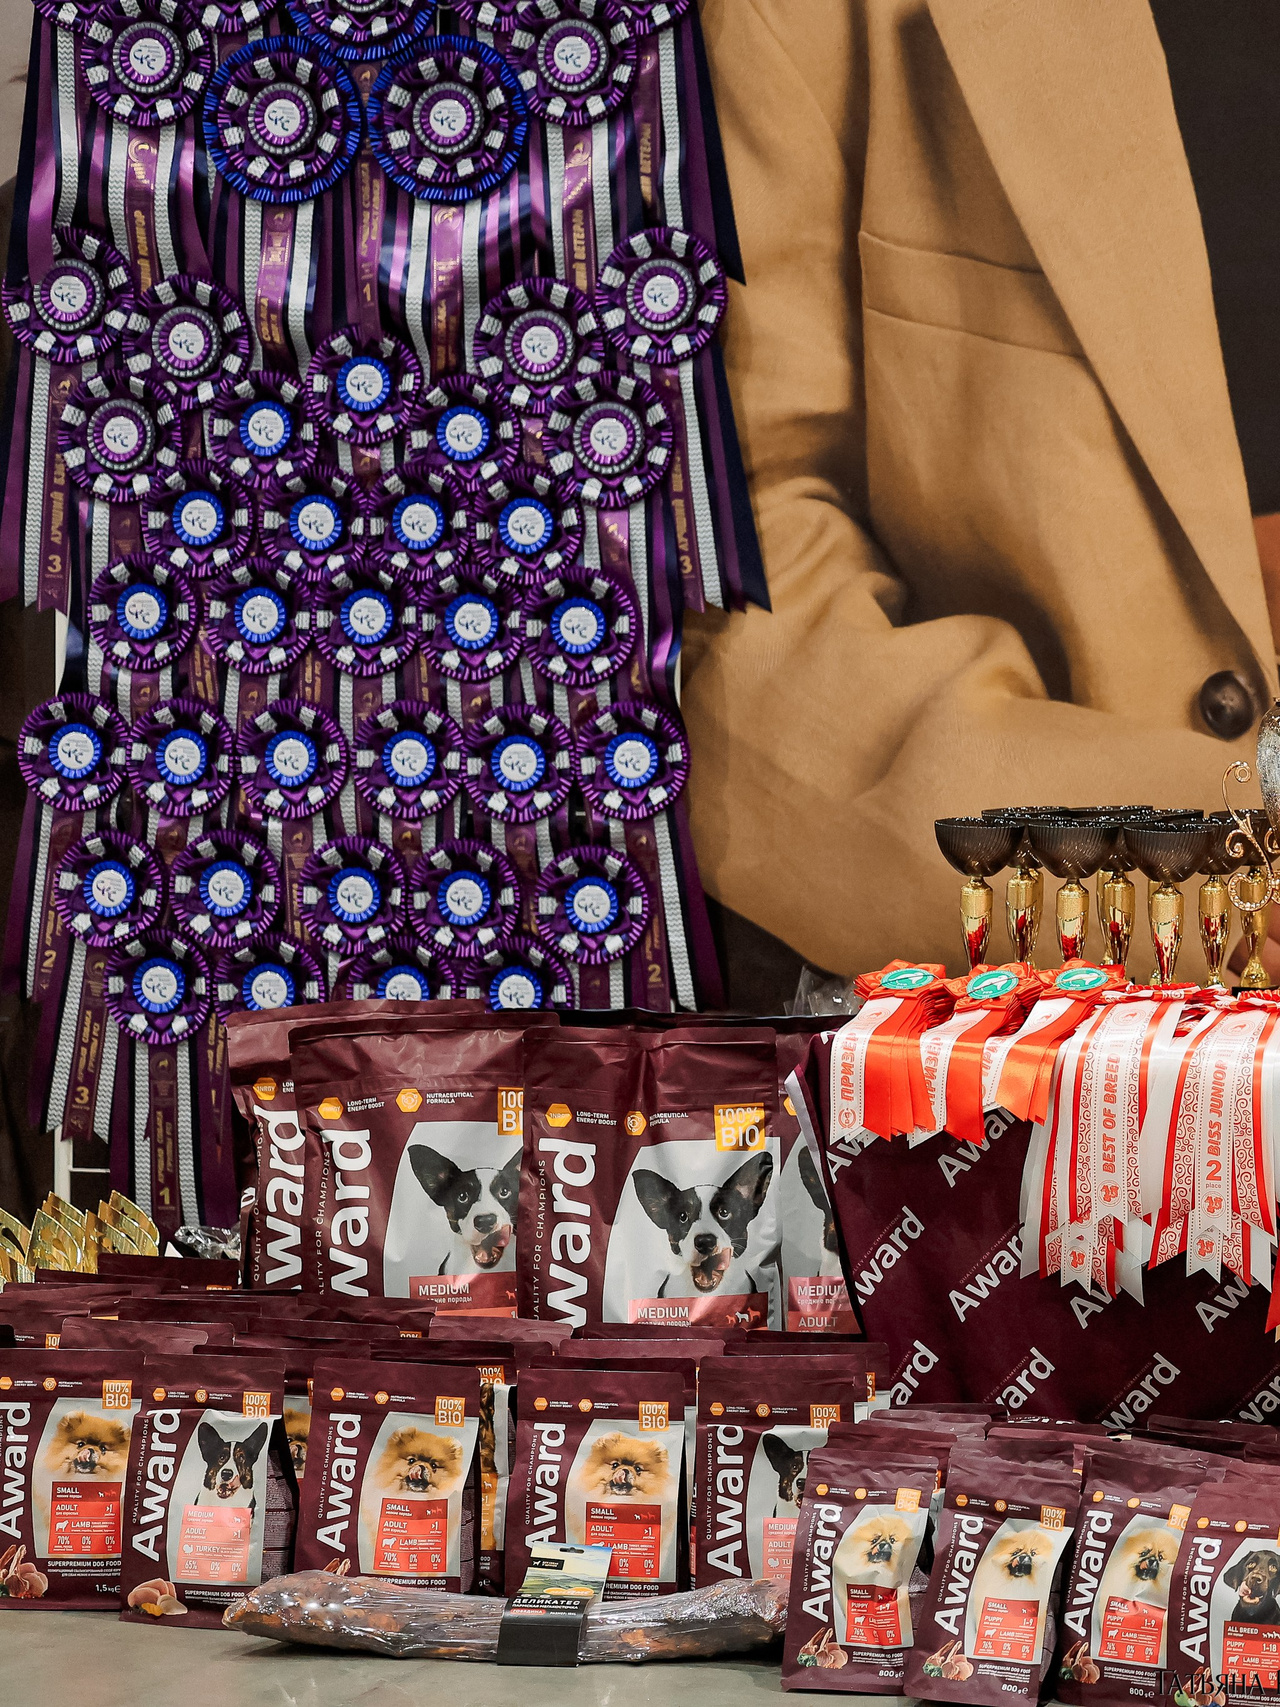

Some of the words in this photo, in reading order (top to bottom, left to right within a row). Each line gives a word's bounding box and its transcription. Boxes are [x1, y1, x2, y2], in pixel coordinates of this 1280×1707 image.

[48, 555, 62, 572] 3
[680, 556, 692, 573] 3
[42, 950, 57, 970] 2
[648, 964, 661, 983] 2
[1104, 1053, 1120, 1104] BREED
[1209, 1060, 1228, 1117] JUNIOR
[75, 1086, 89, 1105] 3
[718, 1108, 760, 1124] 100%
[1103, 1108, 1116, 1129] OF
[721, 1126, 759, 1147] BIO
[1208, 1120, 1222, 1156] BISS
[1103, 1134, 1116, 1173] BEST
[1206, 1160, 1221, 1181] 2
[253, 1105, 306, 1290] ward
[319, 1129, 371, 1297] ward
[949, 1222, 1025, 1323] Awar
[419, 1285, 469, 1296] MEDIUM
[637, 1306, 689, 1319] MEDIUM
[799, 1317, 837, 1327] ADULT
[106, 1383, 129, 1392] 100%
[106, 1395, 128, 1407] BIO
[245, 1395, 267, 1406] 100%
[438, 1399, 462, 1410] 100%
[642, 1404, 666, 1415] 100%
[246, 1408, 267, 1418] BIO
[438, 1411, 461, 1424] BIO
[642, 1417, 665, 1428] BIO
[323, 1426, 334, 1468] CHAMPIONS
[528, 1435, 537, 1474] CHAMPIONS
[0, 1402, 30, 1539] Award
[132, 1489, 140, 1523] QUALITY
[139, 1419, 149, 1467] CHAMPIONS
[132, 1409, 181, 1562] Award
[317, 1413, 361, 1552] Award
[707, 1424, 744, 1577] Award
[82, 1536, 91, 1544] 0%
[105, 1536, 115, 1544] 0%
[196, 1545, 221, 1553] TURKEY
[802, 1504, 843, 1623] Award
[1064, 1510, 1113, 1637] Award
[934, 1514, 984, 1636] Award
[1180, 1537, 1222, 1664] Award
[1145, 1619, 1156, 1627] 1-9
